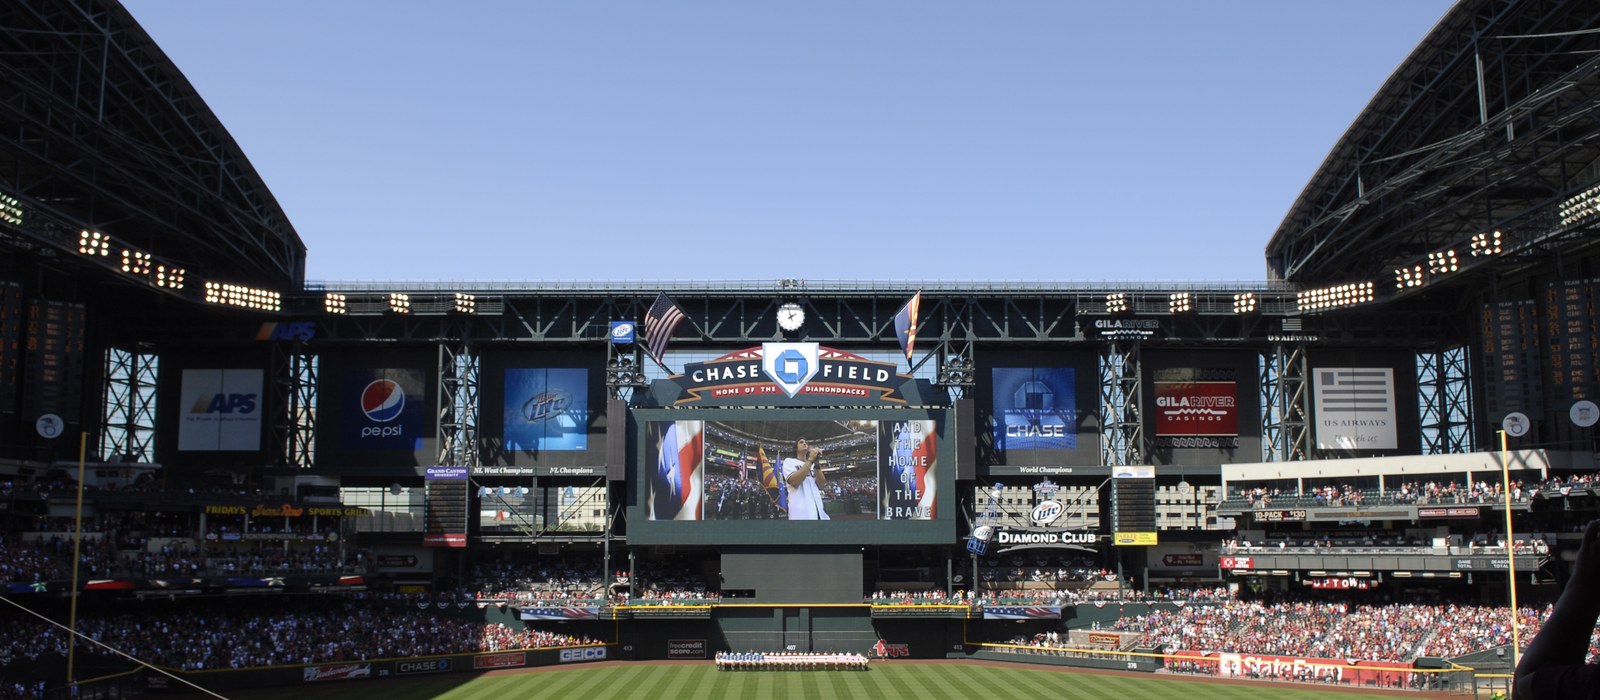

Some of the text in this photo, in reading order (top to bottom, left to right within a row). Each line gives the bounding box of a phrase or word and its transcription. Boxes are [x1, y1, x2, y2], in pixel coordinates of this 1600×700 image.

[271, 321, 317, 341] APS
[692, 364, 889, 383] CHASE FIELD
[716, 388, 740, 396] HOME
[805, 386, 866, 396] DIAMONDBACKS
[207, 393, 258, 414] APS
[1156, 396, 1190, 407] GILA
[893, 422, 921, 433] AND
[1324, 419, 1387, 427] US AIRWAYS
[361, 423, 403, 438] pepsi
[1006, 424, 1065, 437] CHASE
[894, 439, 921, 450] THE
[888, 455, 928, 467] HOME
[474, 466, 484, 474] NL
[500, 467, 534, 475] Champions
[550, 466, 594, 475] NL Champions
[1019, 466, 1073, 475] World Champions
[900, 472, 917, 484] OF
[895, 489, 921, 501] THE
[205, 505, 247, 515] FRIDAYS
[308, 507, 342, 516] SPORTS
[886, 506, 932, 518] BRAVE
[1255, 511, 1283, 519] 10-PACK
[998, 531, 1097, 544] DIAMOND CLUB
[1313, 577, 1366, 588] UPTOWN
[562, 648, 606, 661] GEICO
[400, 661, 437, 672] CHASE
